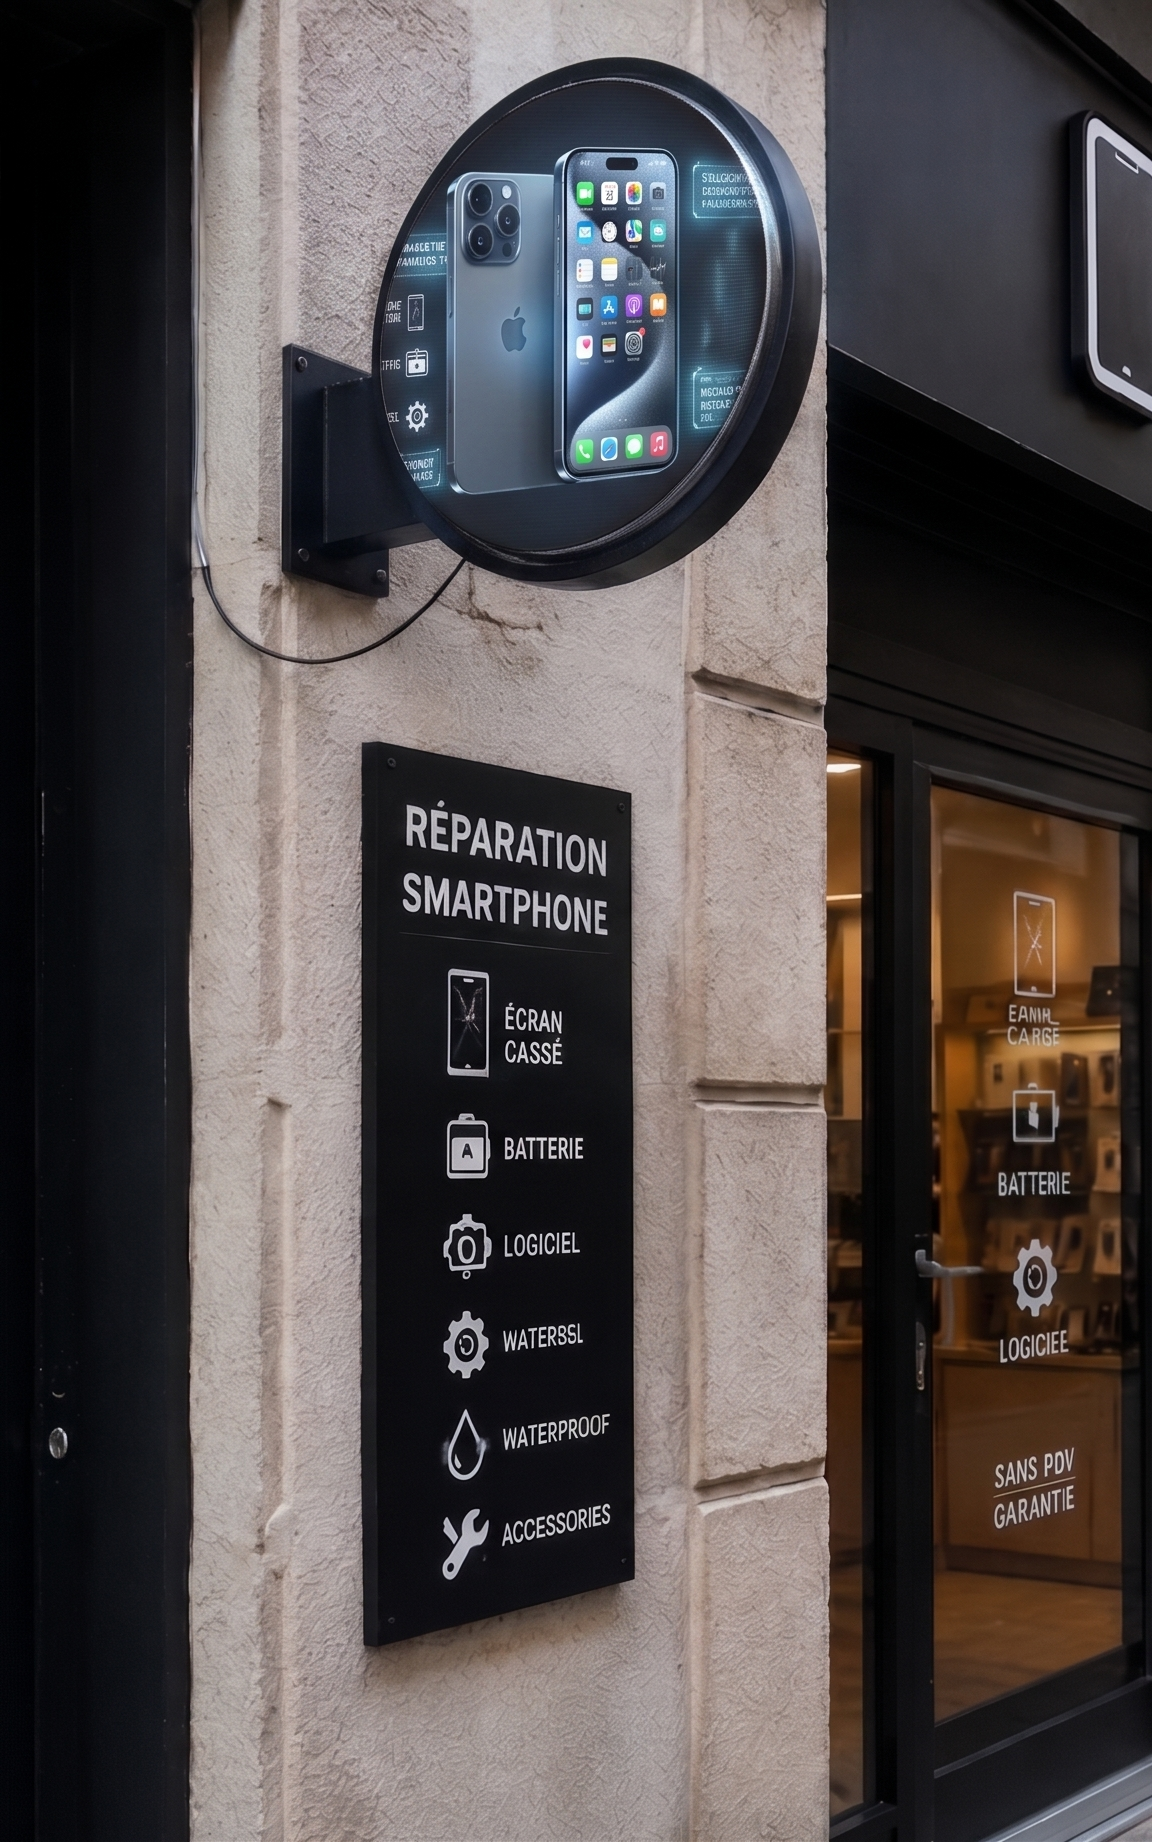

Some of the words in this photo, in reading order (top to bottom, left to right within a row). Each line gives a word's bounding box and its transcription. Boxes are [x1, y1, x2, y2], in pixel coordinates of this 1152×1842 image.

[404, 799, 608, 877] RÉPARATION
[402, 872, 609, 936] SMARTPHONE
[505, 1002, 563, 1034] ÉCRAN
[504, 1037, 563, 1065] CASSÉ
[504, 1137, 584, 1160] BATTERIE
[998, 1171, 1071, 1196] BATTERIE
[504, 1231, 581, 1258] LOGICIEL
[1000, 1330, 1069, 1364] LOGICIEE
[503, 1413, 611, 1451] WATERPROOF
[994, 1456, 1038, 1489] SANS
[993, 1485, 1076, 1529] GARANTIE
[502, 1503, 611, 1547] ACCESSORIES
